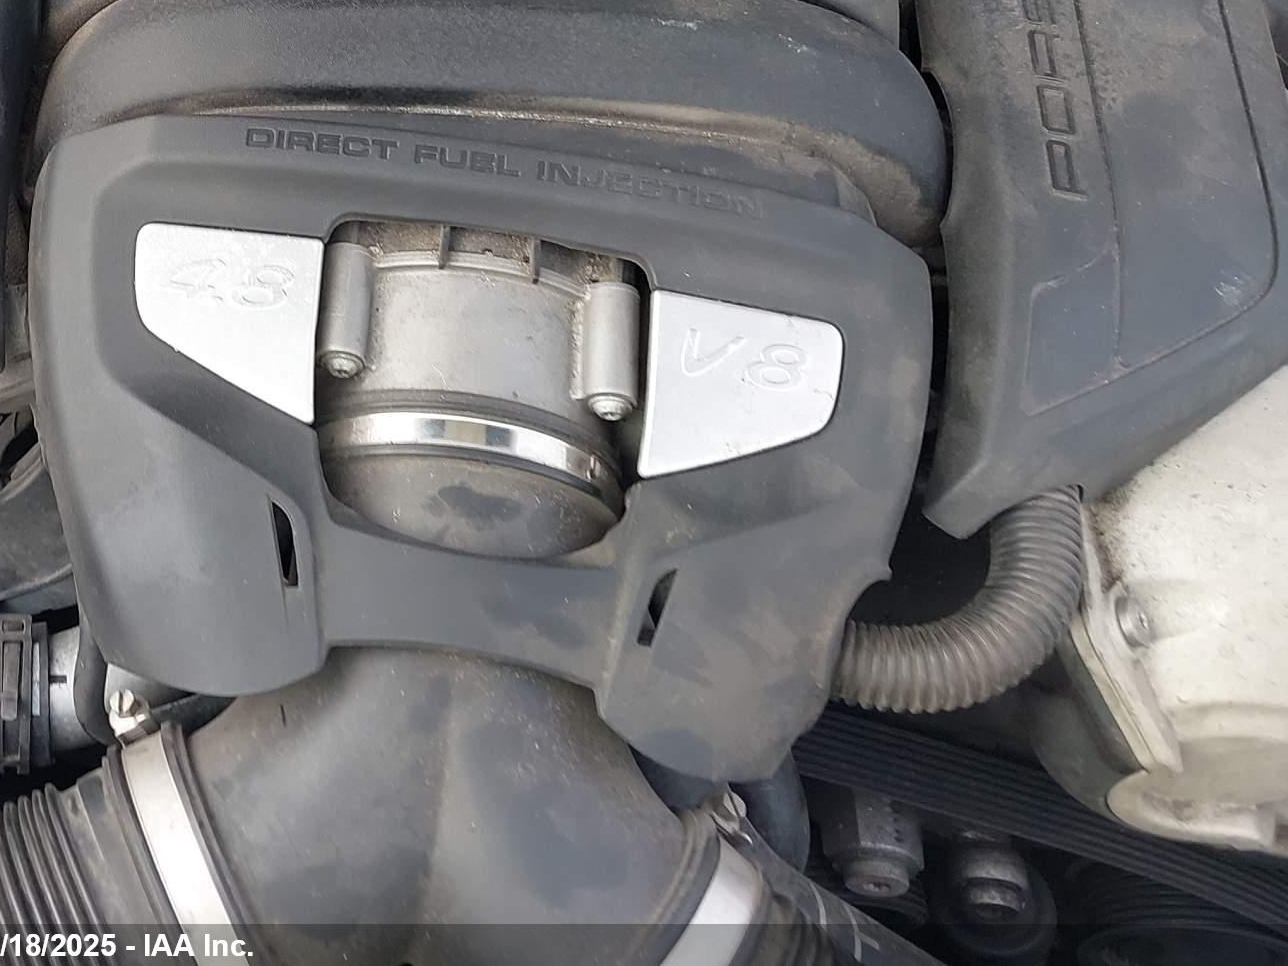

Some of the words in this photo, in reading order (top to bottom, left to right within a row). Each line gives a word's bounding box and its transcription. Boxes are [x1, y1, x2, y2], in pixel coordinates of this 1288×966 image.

[245, 126, 400, 160] DIRECT
[413, 143, 521, 178] FUEL
[536, 160, 763, 220] INJECTION
[681, 328, 809, 391] V8
